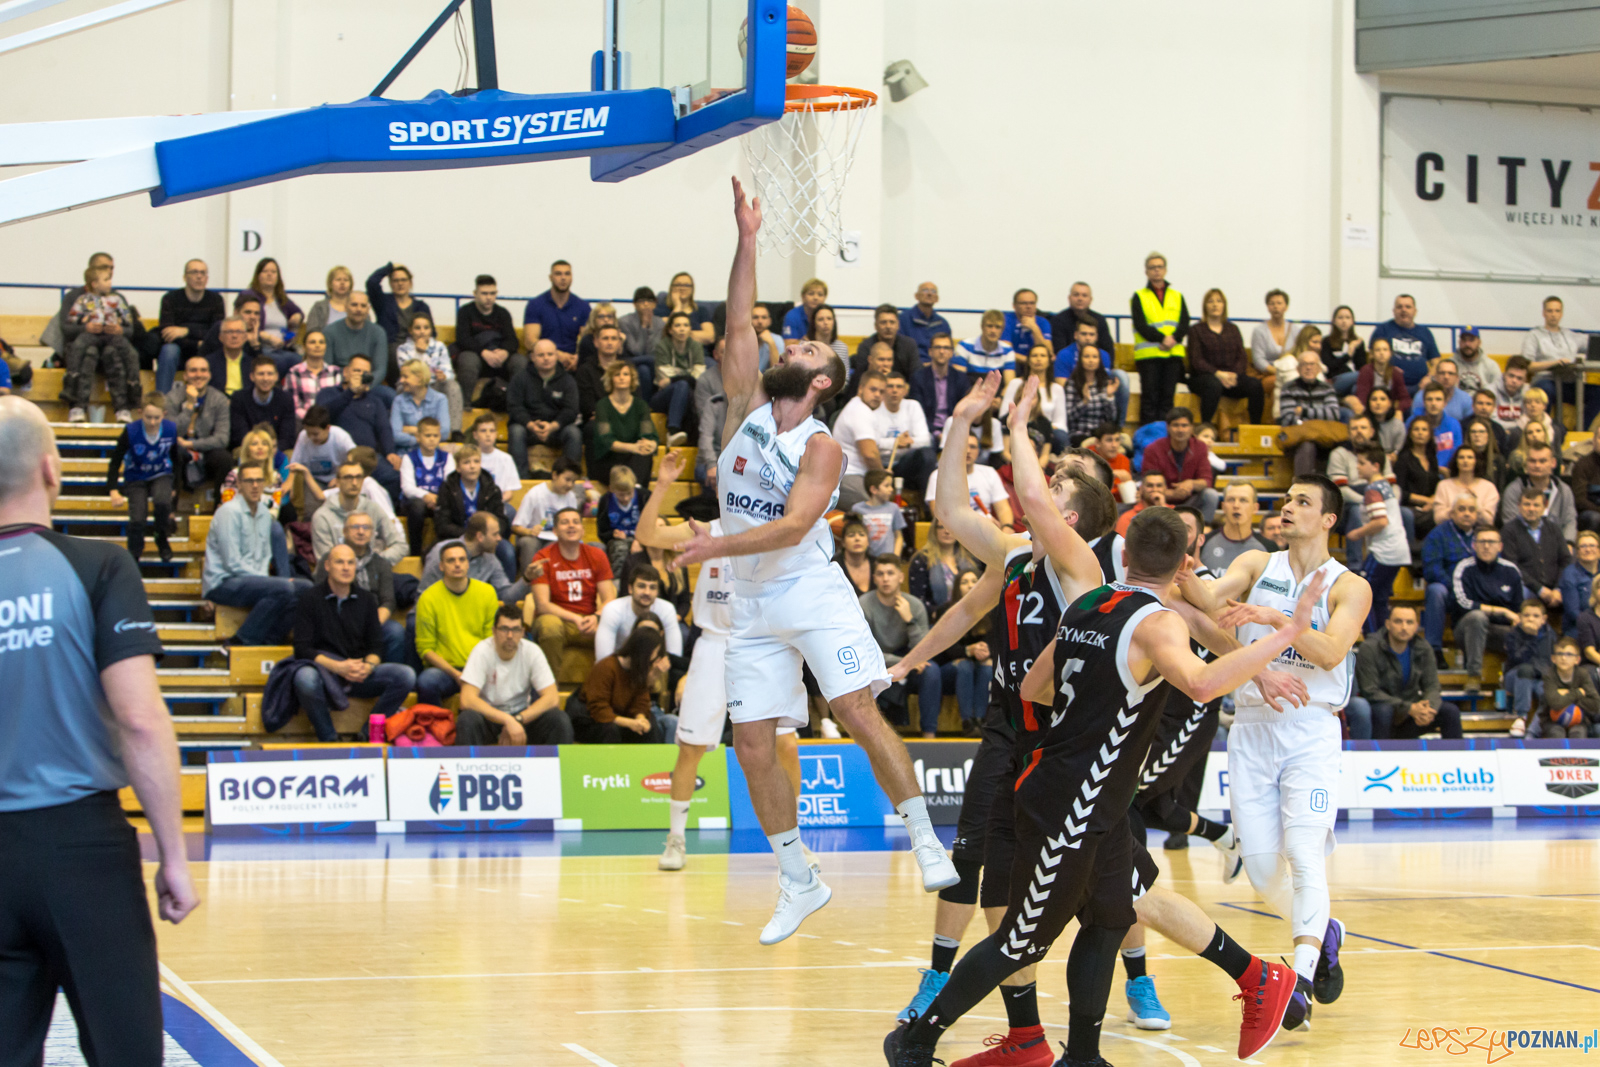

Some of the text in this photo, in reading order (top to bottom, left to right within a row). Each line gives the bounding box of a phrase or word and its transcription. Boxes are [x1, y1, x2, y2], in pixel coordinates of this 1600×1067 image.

[389, 105, 612, 146] SPORT SYSTEM
[1505, 211, 1555, 227] WIĘCEJ
[1561, 214, 1583, 227] NIŻ
[242, 229, 263, 252] D
[840, 240, 859, 263] C
[759, 463, 776, 491] 9
[726, 491, 786, 518] BIOFAR
[567, 580, 583, 602] 13
[706, 590, 730, 601] BIOF
[1015, 590, 1045, 626] 12
[837, 645, 861, 675] 9
[456, 763, 523, 775] fundacja
[1399, 767, 1495, 786] funclub
[1549, 769, 1594, 782] JOKER
[219, 775, 369, 801] BIOFARM
[458, 774, 524, 812] PBG
[583, 774, 631, 791] Frytki
[1402, 785, 1438, 793] biuro
[798, 796, 847, 816] OTEL
[1310, 788, 1329, 813] 0
[798, 814, 849, 826] ZNAŃSKI
